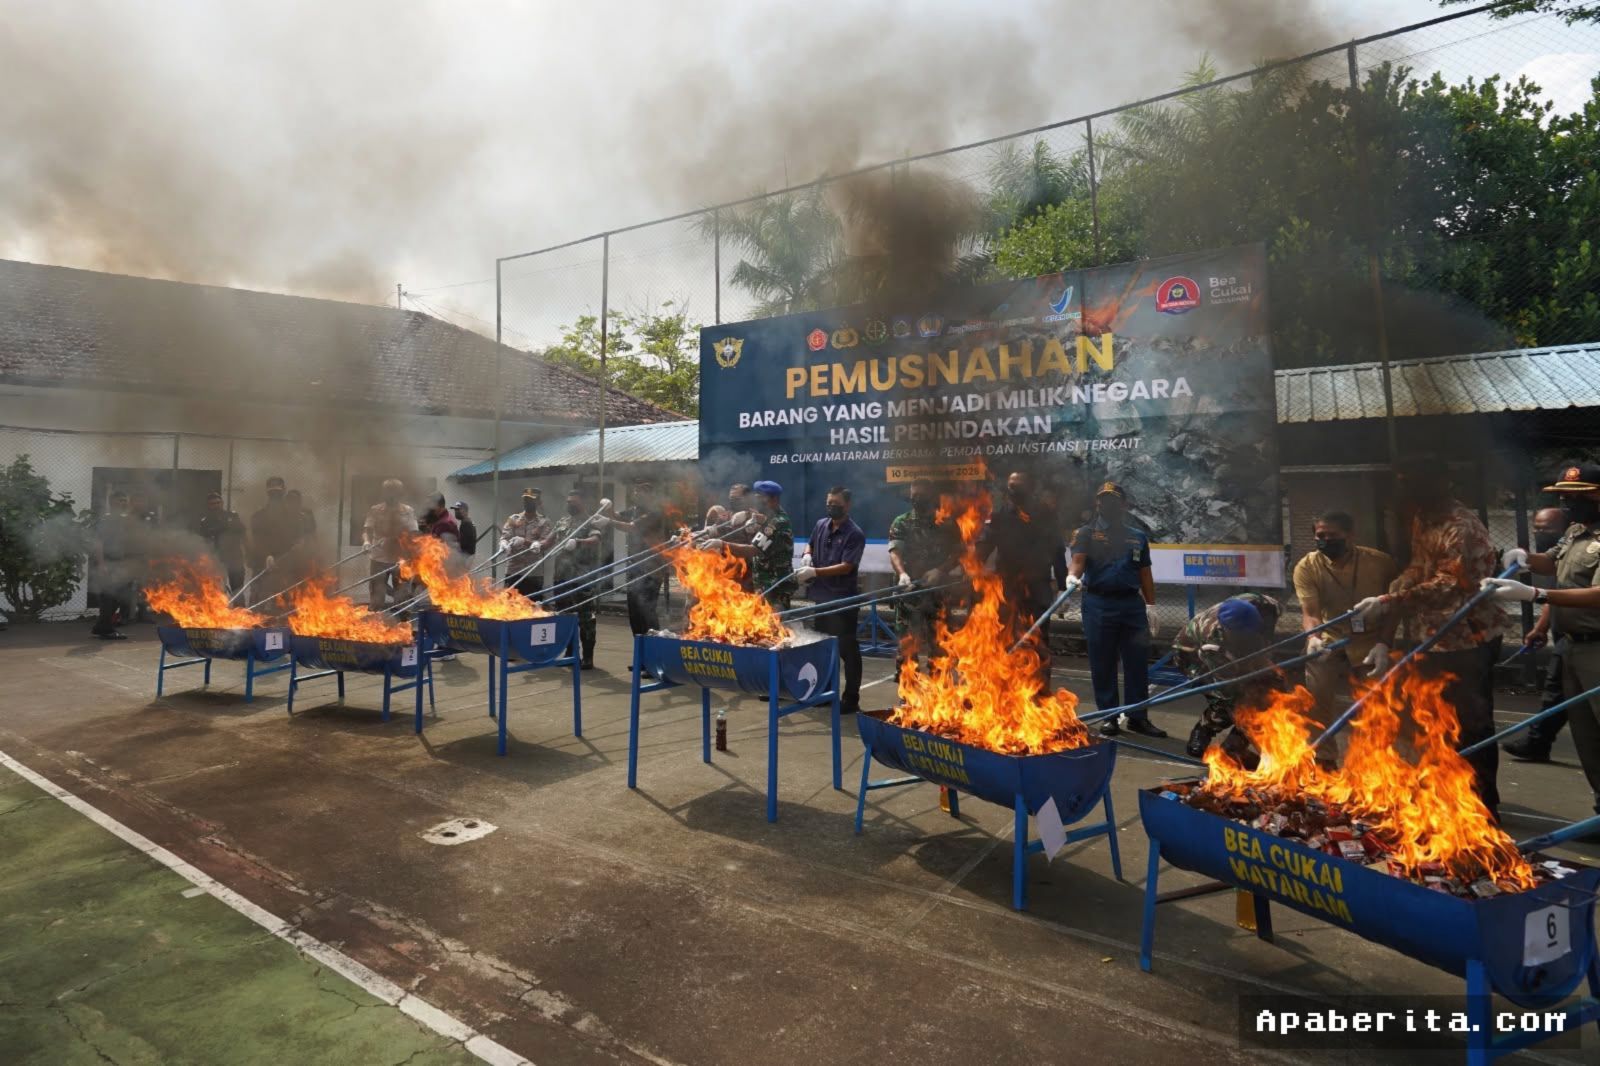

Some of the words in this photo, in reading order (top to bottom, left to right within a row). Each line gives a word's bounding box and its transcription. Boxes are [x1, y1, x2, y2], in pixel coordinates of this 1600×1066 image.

[1209, 277, 1236, 287] Bea
[1211, 283, 1252, 298] Cukai
[786, 332, 1114, 399] PEMUSNAHAN
[739, 406, 818, 428] BARANG
[822, 402, 882, 422] YANG
[888, 394, 991, 418] MENJADI
[997, 386, 1065, 410] MILIK
[1072, 377, 1193, 404] NEGARA
[830, 426, 889, 445] HASIL
[894, 415, 1052, 442] PENINDAKAN
[770, 455, 788, 464] BEA
[791, 453, 822, 463] CUKAI
[824, 452, 879, 462] MATARAM
[940, 446, 982, 457] PEMDA
[986, 443, 1017, 455] DAN
[1018, 440, 1080, 453] INSTANSI
[1084, 437, 1141, 450] TERKAIT
[892, 469, 901, 477] 10
[903, 468, 952, 478] Septem
[752, 531, 773, 551] PM
[680, 646, 699, 660] BEA
[702, 648, 733, 665] CUKAI
[683, 663, 736, 680] MATARAM
[903, 733, 926, 753] BEA
[928, 740, 964, 767] CUKAI
[1224, 826, 1265, 863] BEA
[1269, 844, 1343, 893] CUKAI
[1229, 856, 1353, 923] MATARAM
[1546, 912, 1557, 940] 6
